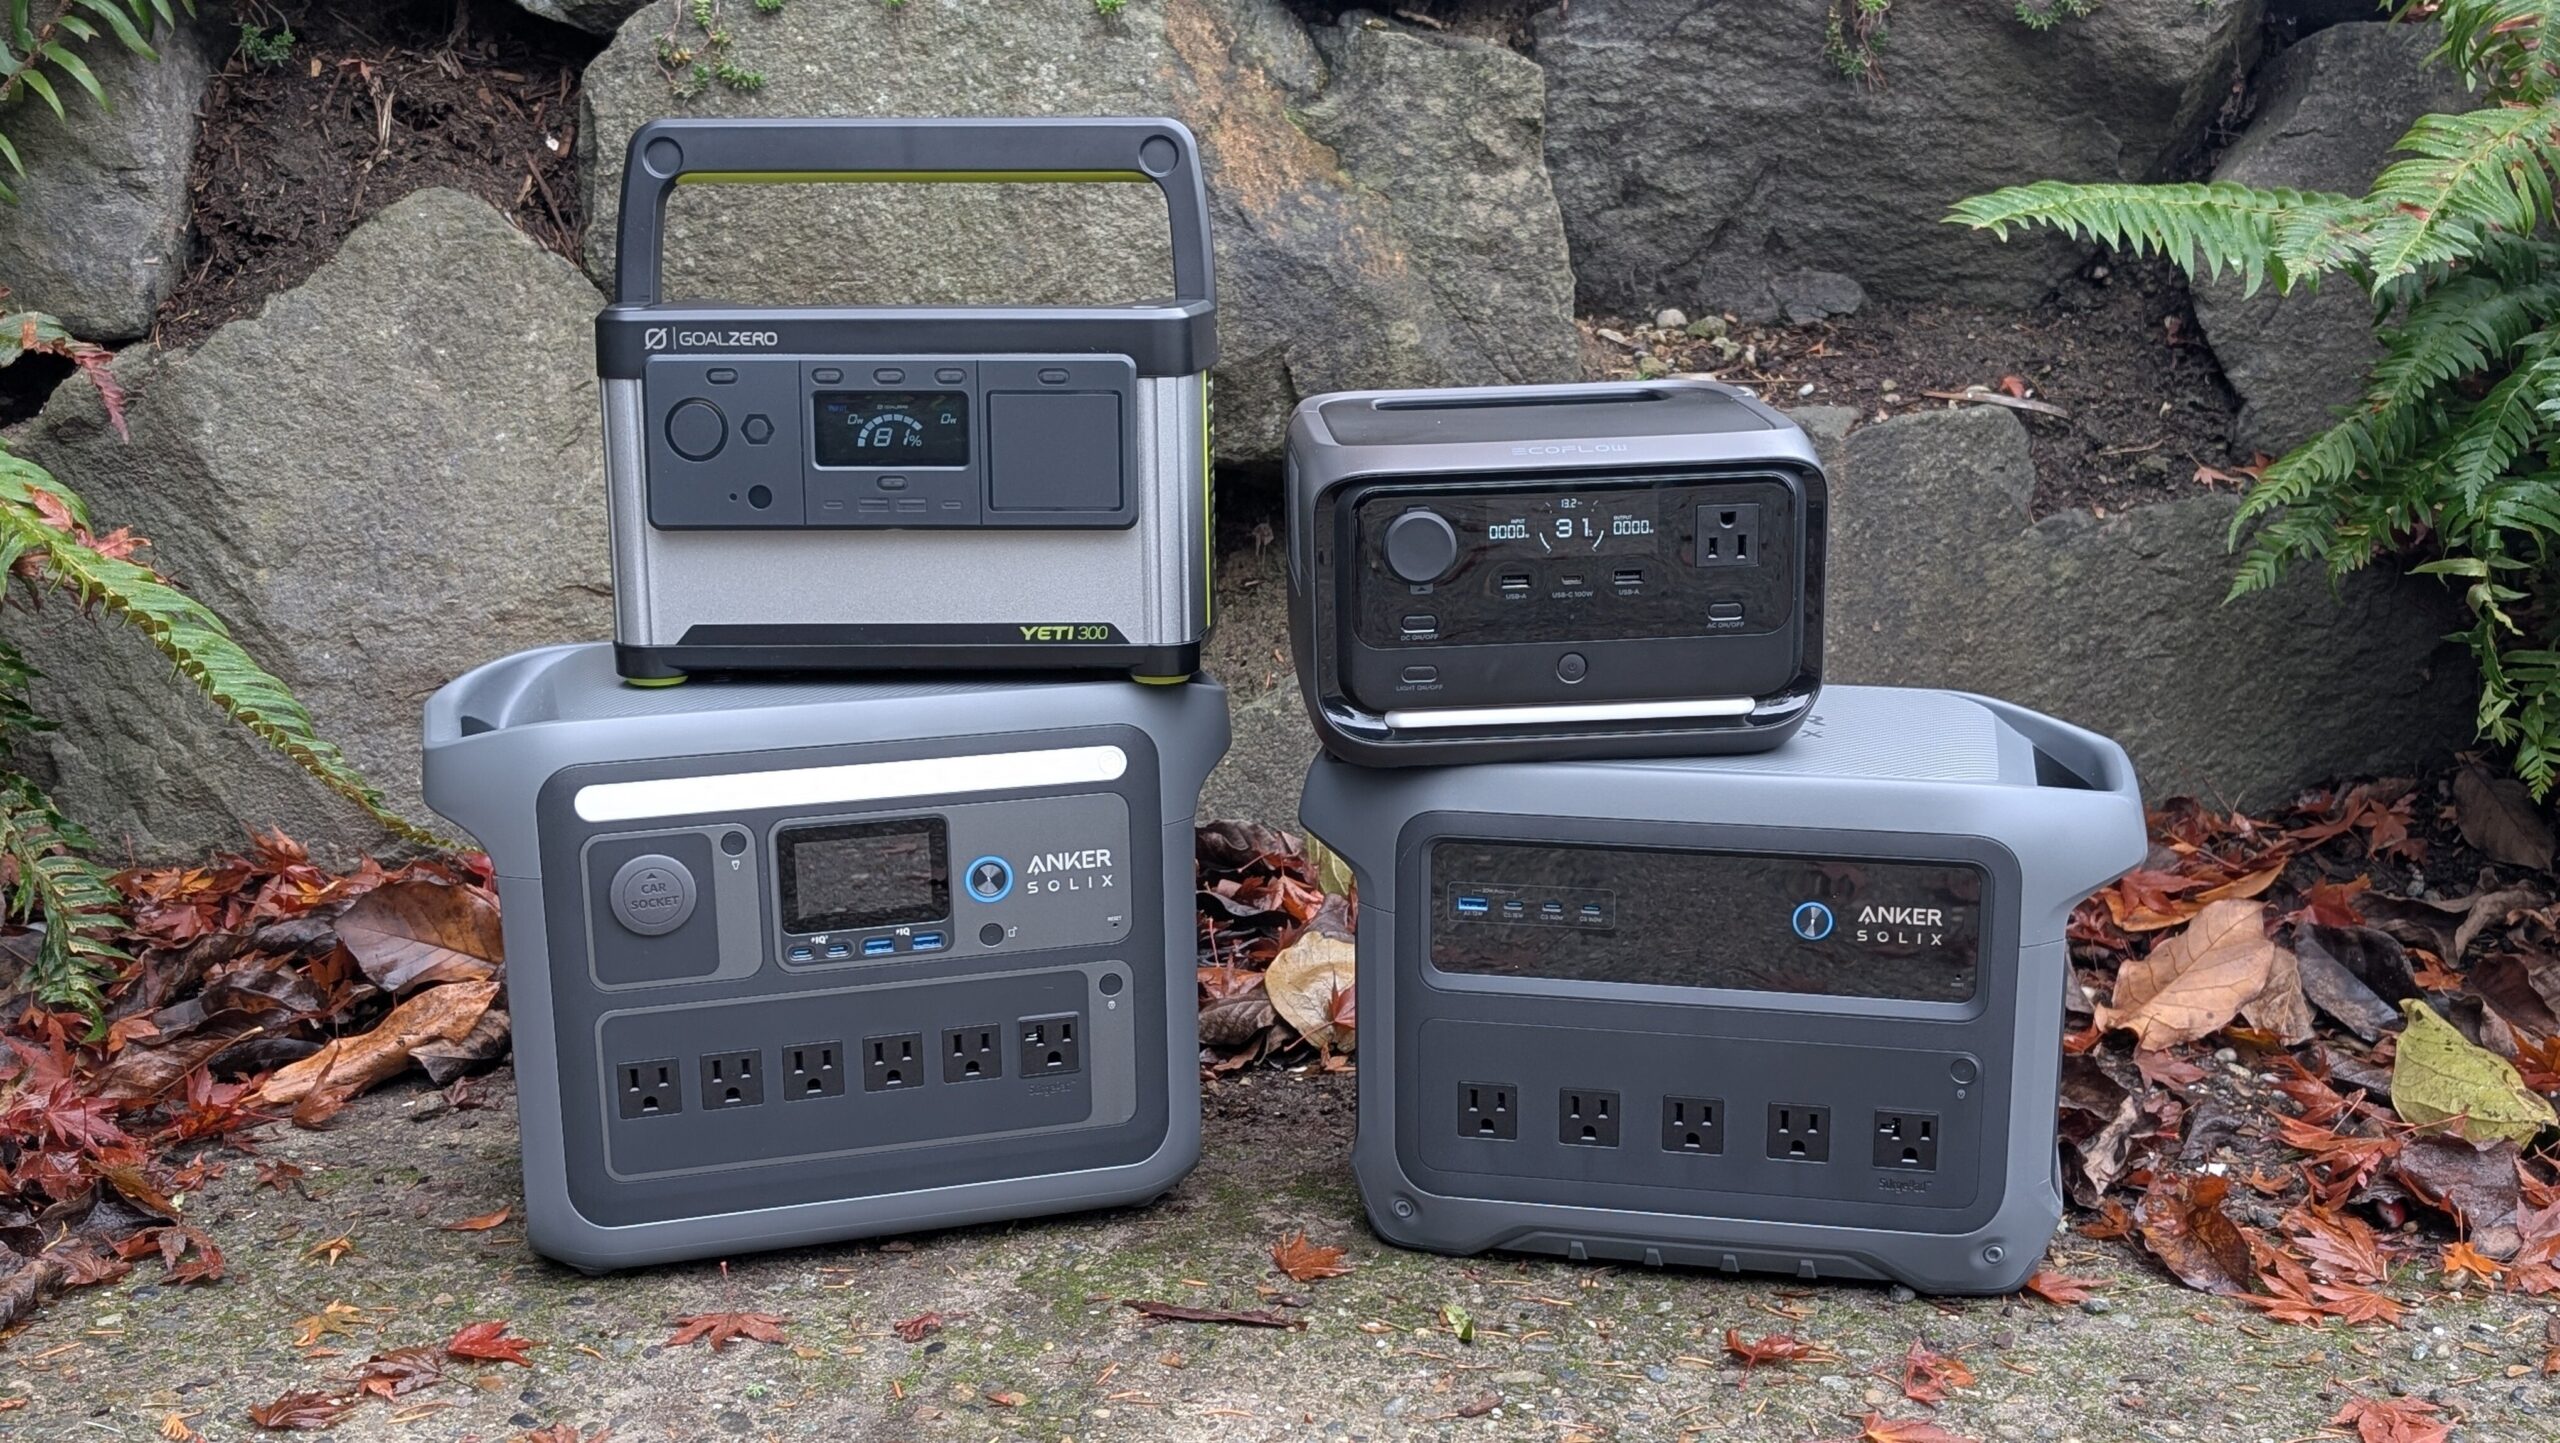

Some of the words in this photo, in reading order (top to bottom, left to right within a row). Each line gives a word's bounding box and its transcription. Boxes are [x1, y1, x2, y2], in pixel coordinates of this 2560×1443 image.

[679, 331, 778, 346] GOALZERO
[1511, 443, 1627, 456] ECOFLOW
[1019, 625, 1074, 640] YETI
[1077, 625, 1109, 640] 300
[1027, 848, 1112, 876] ANKER
[641, 882, 667, 895] CAR
[1026, 874, 1114, 895] SOLIX
[631, 895, 679, 911] SOCKET
[1858, 905, 1943, 927] ANKER
[1857, 929, 1942, 946] SOLIX
